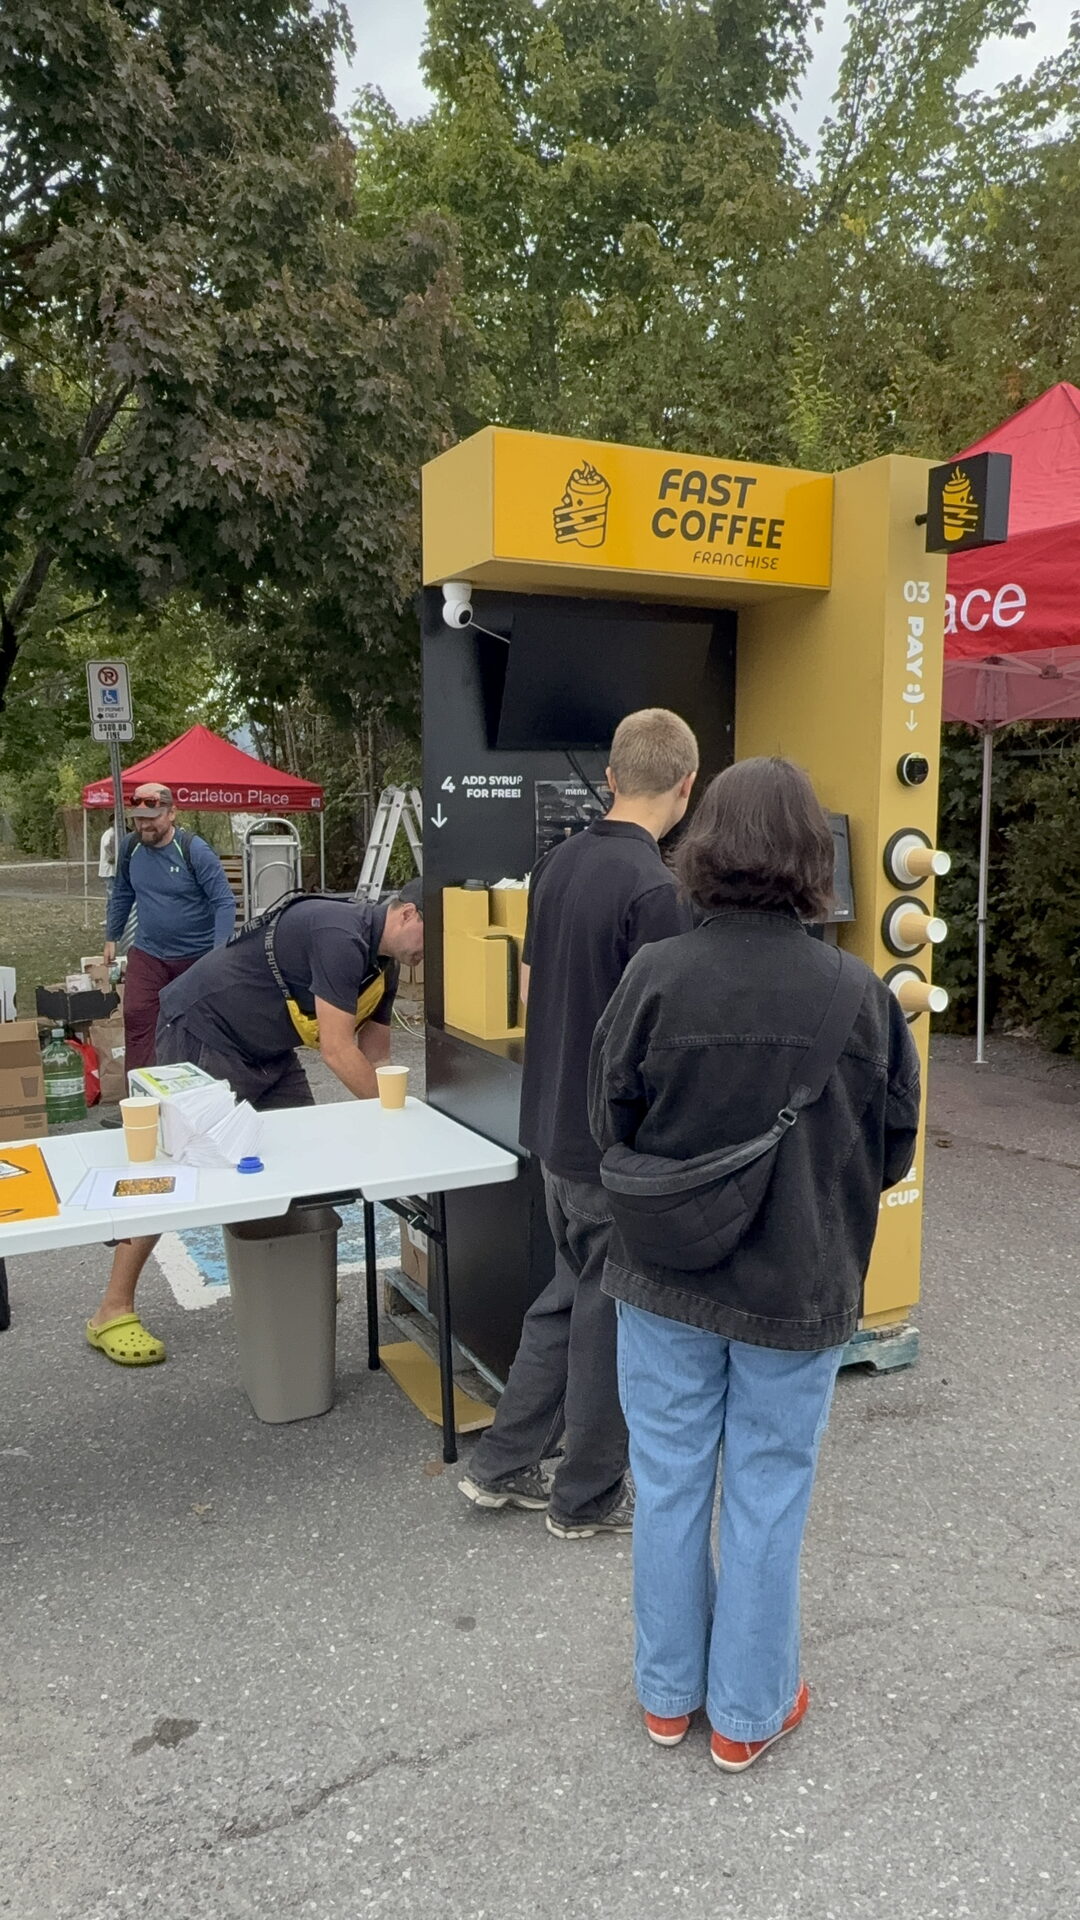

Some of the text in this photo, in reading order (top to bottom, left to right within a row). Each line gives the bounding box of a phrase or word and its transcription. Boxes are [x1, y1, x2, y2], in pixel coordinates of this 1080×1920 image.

[658, 468, 757, 508] FAST
[651, 507, 785, 550] COFFEE
[692, 551, 780, 570] FRANCHISE
[903, 581, 930, 603] 03
[906, 616, 925, 678] PAY
[99, 723, 127, 731] $300.00
[106, 731, 120, 739] FINE
[441, 776, 456, 793] 4
[462, 775, 523, 785] ADD SYRUP
[177, 788, 289, 805] Carleton Place
[466, 789, 521, 798] FOR FREE!
[886, 1188, 920, 1207] CUP
